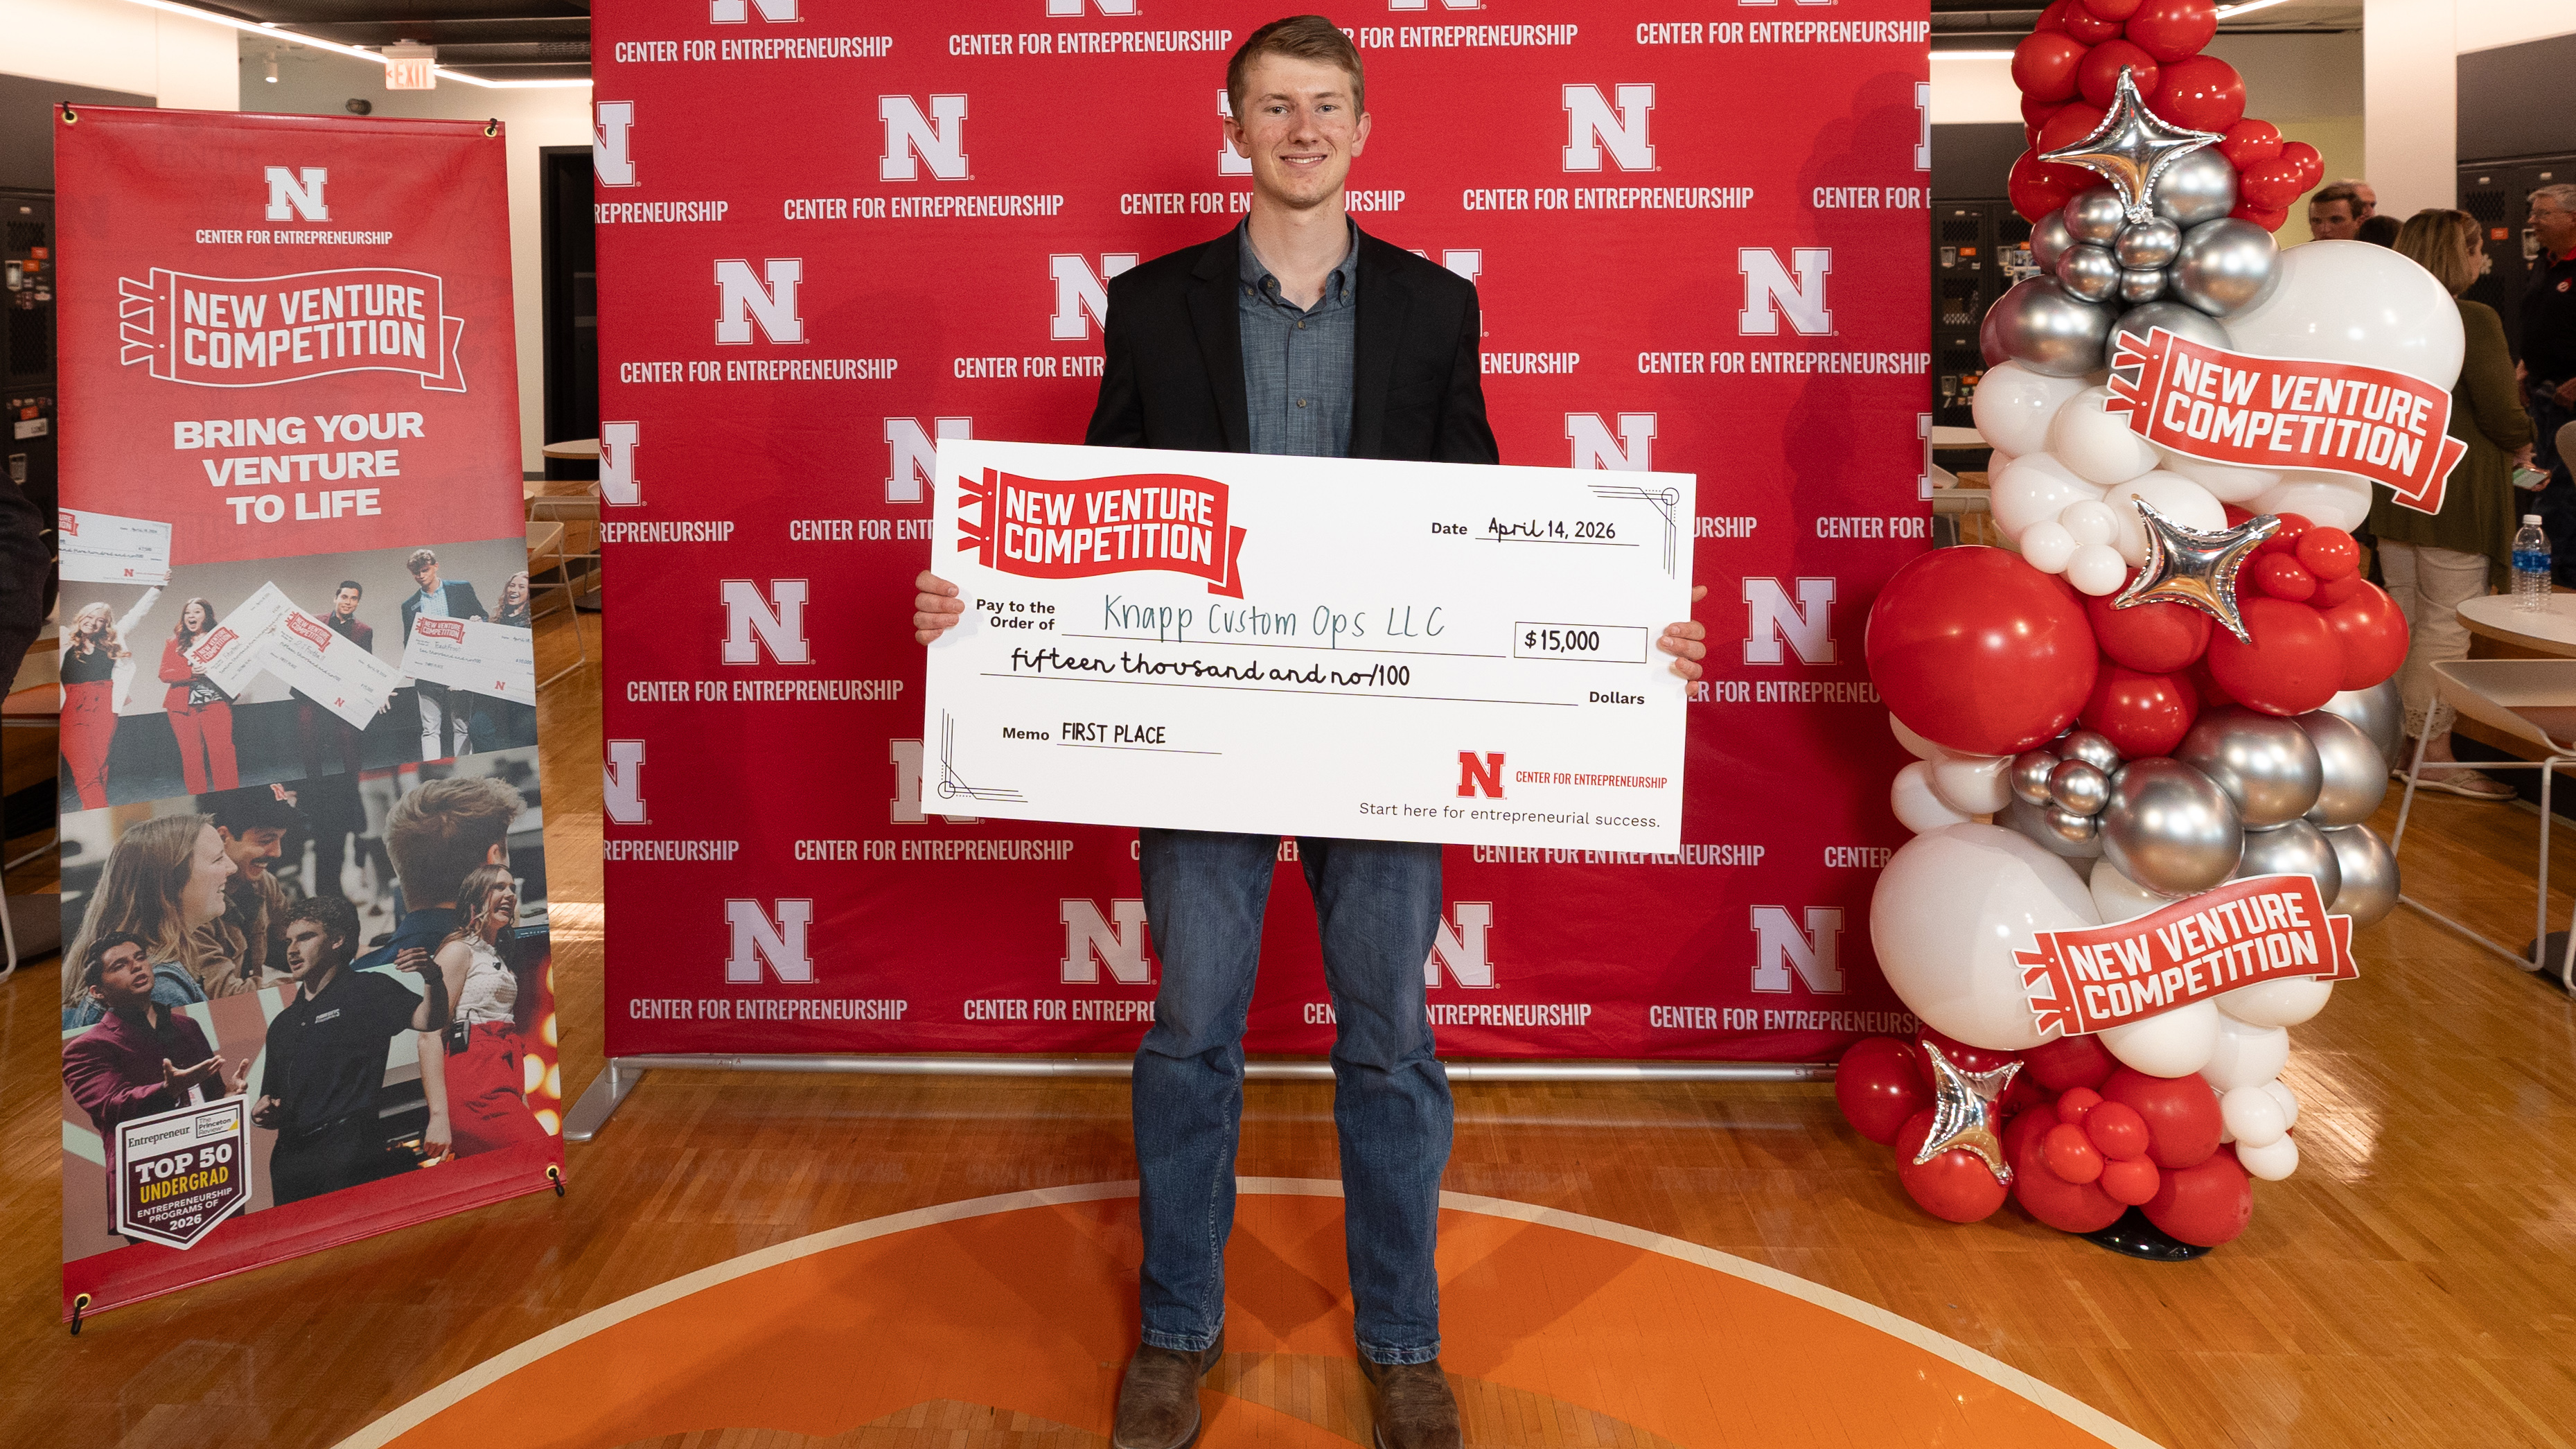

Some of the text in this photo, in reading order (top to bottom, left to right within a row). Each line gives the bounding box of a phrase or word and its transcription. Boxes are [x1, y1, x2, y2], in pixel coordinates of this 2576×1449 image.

[949, 30, 1232, 55] CENTER FOR ENTREPRENEURSHIP
[1361, 27, 1394, 48] FOR
[1401, 24, 1578, 47] ENTREPRENEURSHIP
[1637, 21, 1930, 44] CENTER FOR ENTREPRENEURSHIP
[616, 37, 892, 62] CENTER FOR ENTREPRENEURSHIP
[394, 60, 429, 88] EXIT
[879, 94, 969, 182] N
[1562, 82, 1655, 173] N
[265, 166, 328, 221] N
[1121, 193, 1184, 214] CENTER
[1191, 193, 1224, 213] FOR
[1463, 188, 1754, 210] CENTER FOR ENTREPRENEURSHIP
[1813, 187, 1879, 209] CENTER
[1886, 187, 1920, 209] FOR
[594, 201, 728, 223] REPRENEURSHIP
[784, 195, 1064, 220] CENTER FOR ENTREPRENEURSHIP
[196, 229, 392, 245] CENTER FOR ENTREPRENEURSHIP
[714, 257, 804, 345] N
[1738, 247, 1832, 337] N
[184, 284, 425, 328] NEW VENTURE
[184, 319, 425, 369] COMPETITION
[621, 359, 897, 383] CENTER FOR ENTREPRENEURSHIP
[954, 358, 1017, 378] CENTER
[1023, 357, 1056, 378] FOR
[1481, 353, 1580, 374] ENEURSHIP
[1639, 352, 1930, 374] CENTER FOR ENTREPRENEURSHIP
[2172, 352, 2433, 437] NEW VENTURE
[175, 412, 425, 449] BRING YOUR
[2162, 390, 2423, 477] COMPETITION
[202, 450, 400, 487] VENTURE
[227, 489, 381, 525] TO LIFE
[1005, 486, 1215, 527] NEW VENTURE
[600, 521, 734, 543] REPRENEURSHIP
[791, 520, 853, 541] CENTER
[859, 519, 892, 541] FOR
[1432, 517, 1616, 543] Date April 14, 2026
[1817, 517, 1924, 538] CENTER FOR
[1005, 522, 1212, 565] COMPETITION
[976, 599, 1055, 615] Pay to the
[721, 579, 809, 665] N
[991, 616, 1055, 631] Order of
[1105, 595, 1445, 649] Knapp Custom Ops LLC
[1742, 577, 1837, 665] N
[1525, 630, 1600, 653] $15,000
[1012, 647, 1410, 686] fifteen thousand and no/100
[627, 680, 903, 701] CENTER FOR ENTREPRENEURSHIP
[1589, 691, 1645, 705] Dollars
[1715, 681, 1750, 702] FOR
[1756, 681, 1880, 703] ENTREPRENEU
[1003, 722, 1166, 744] Memo FIRST PLACE
[1456, 750, 1668, 800] N CENTER FOR ENTREPRENEURSHIP
[1359, 802, 1660, 828] Start here for entrepreneurial success.
[603, 840, 739, 861] REPRENEURSHIP
[795, 840, 1073, 861] CENTER FOR ENTREPRENEURSHIP
[1473, 845, 1539, 863] CENTER
[1824, 846, 1891, 868] CENTER
[725, 898, 813, 984] N
[1060, 898, 1152, 985] N
[2067, 892, 2311, 981] NEW VENTURE
[1750, 905, 1846, 994] N
[2083, 931, 2319, 1019] COMPETITION
[630, 999, 907, 1020] CENTER FOR ENTREPRENEURSHIP
[964, 999, 1027, 1019] CENTER
[1034, 1000, 1066, 1020] FOR
[1426, 1004, 1591, 1026] NTREPRENEURSHIP
[1650, 1005, 1717, 1029] CENTER
[1723, 1008, 1758, 1030] FOR
[199, 1118, 231, 1130] Princeton
[128, 1127, 190, 1148] Entrepreneur
[135, 1143, 232, 1184] TOP 50
[140, 1166, 229, 1203] UNDERGRAD
[137, 1187, 232, 1218] ENTREPRENEURSHIP
[149, 1199, 219, 1223] PROGRAMS OF
[169, 1213, 202, 1231] 2026
